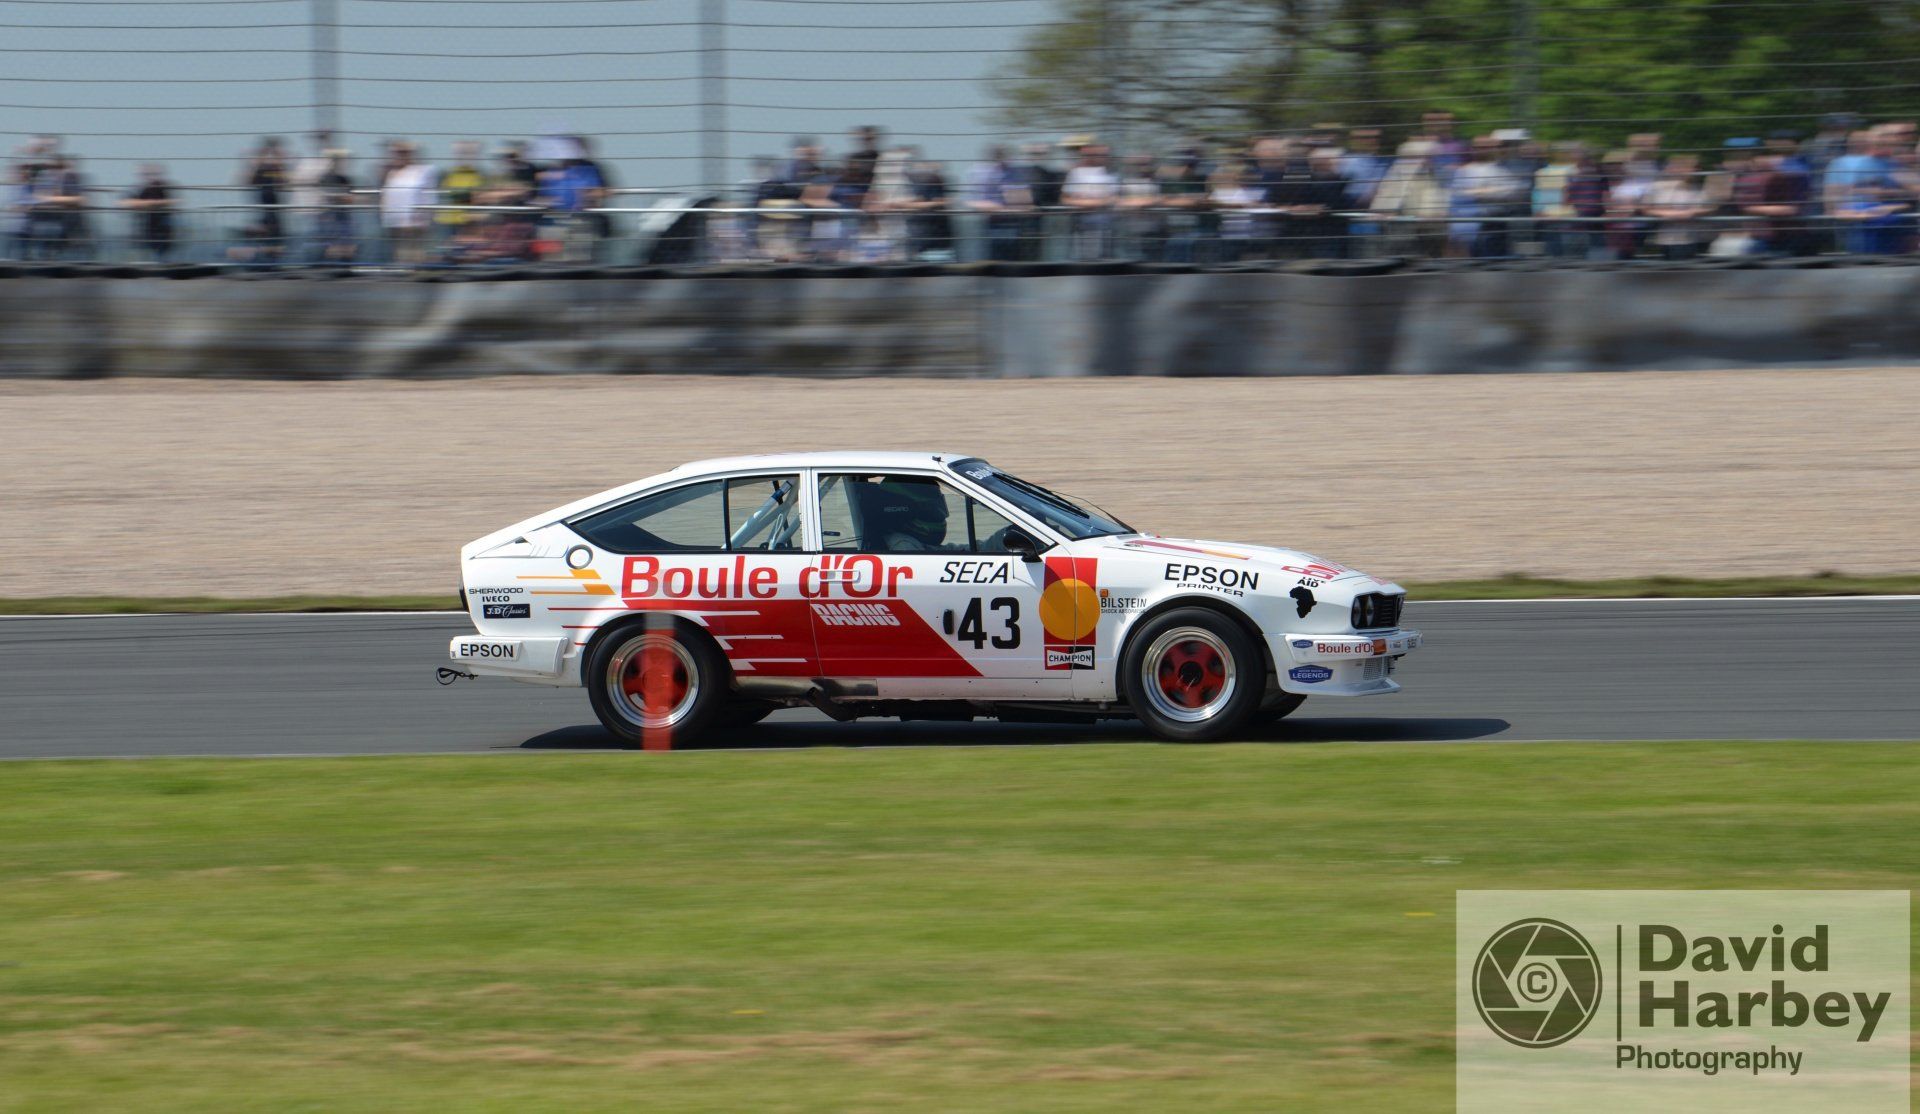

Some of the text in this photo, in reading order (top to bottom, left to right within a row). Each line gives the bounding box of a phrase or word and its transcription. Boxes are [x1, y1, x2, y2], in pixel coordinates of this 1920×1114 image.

[621, 554, 913, 599] Boule d'Or
[940, 561, 1009, 584] SECA
[1164, 563, 1260, 591] EPSON
[468, 587, 524, 595] SHERWOOD
[1176, 583, 1245, 598] PRINTER
[482, 595, 510, 603] IVECO
[1101, 597, 1147, 608] BILSTEIN
[810, 603, 901, 626] RACING
[958, 597, 1021, 650] 43
[461, 643, 514, 658] EPSON
[1317, 643, 1351, 653] Boule
[1048, 654, 1092, 662] CHAMPION
